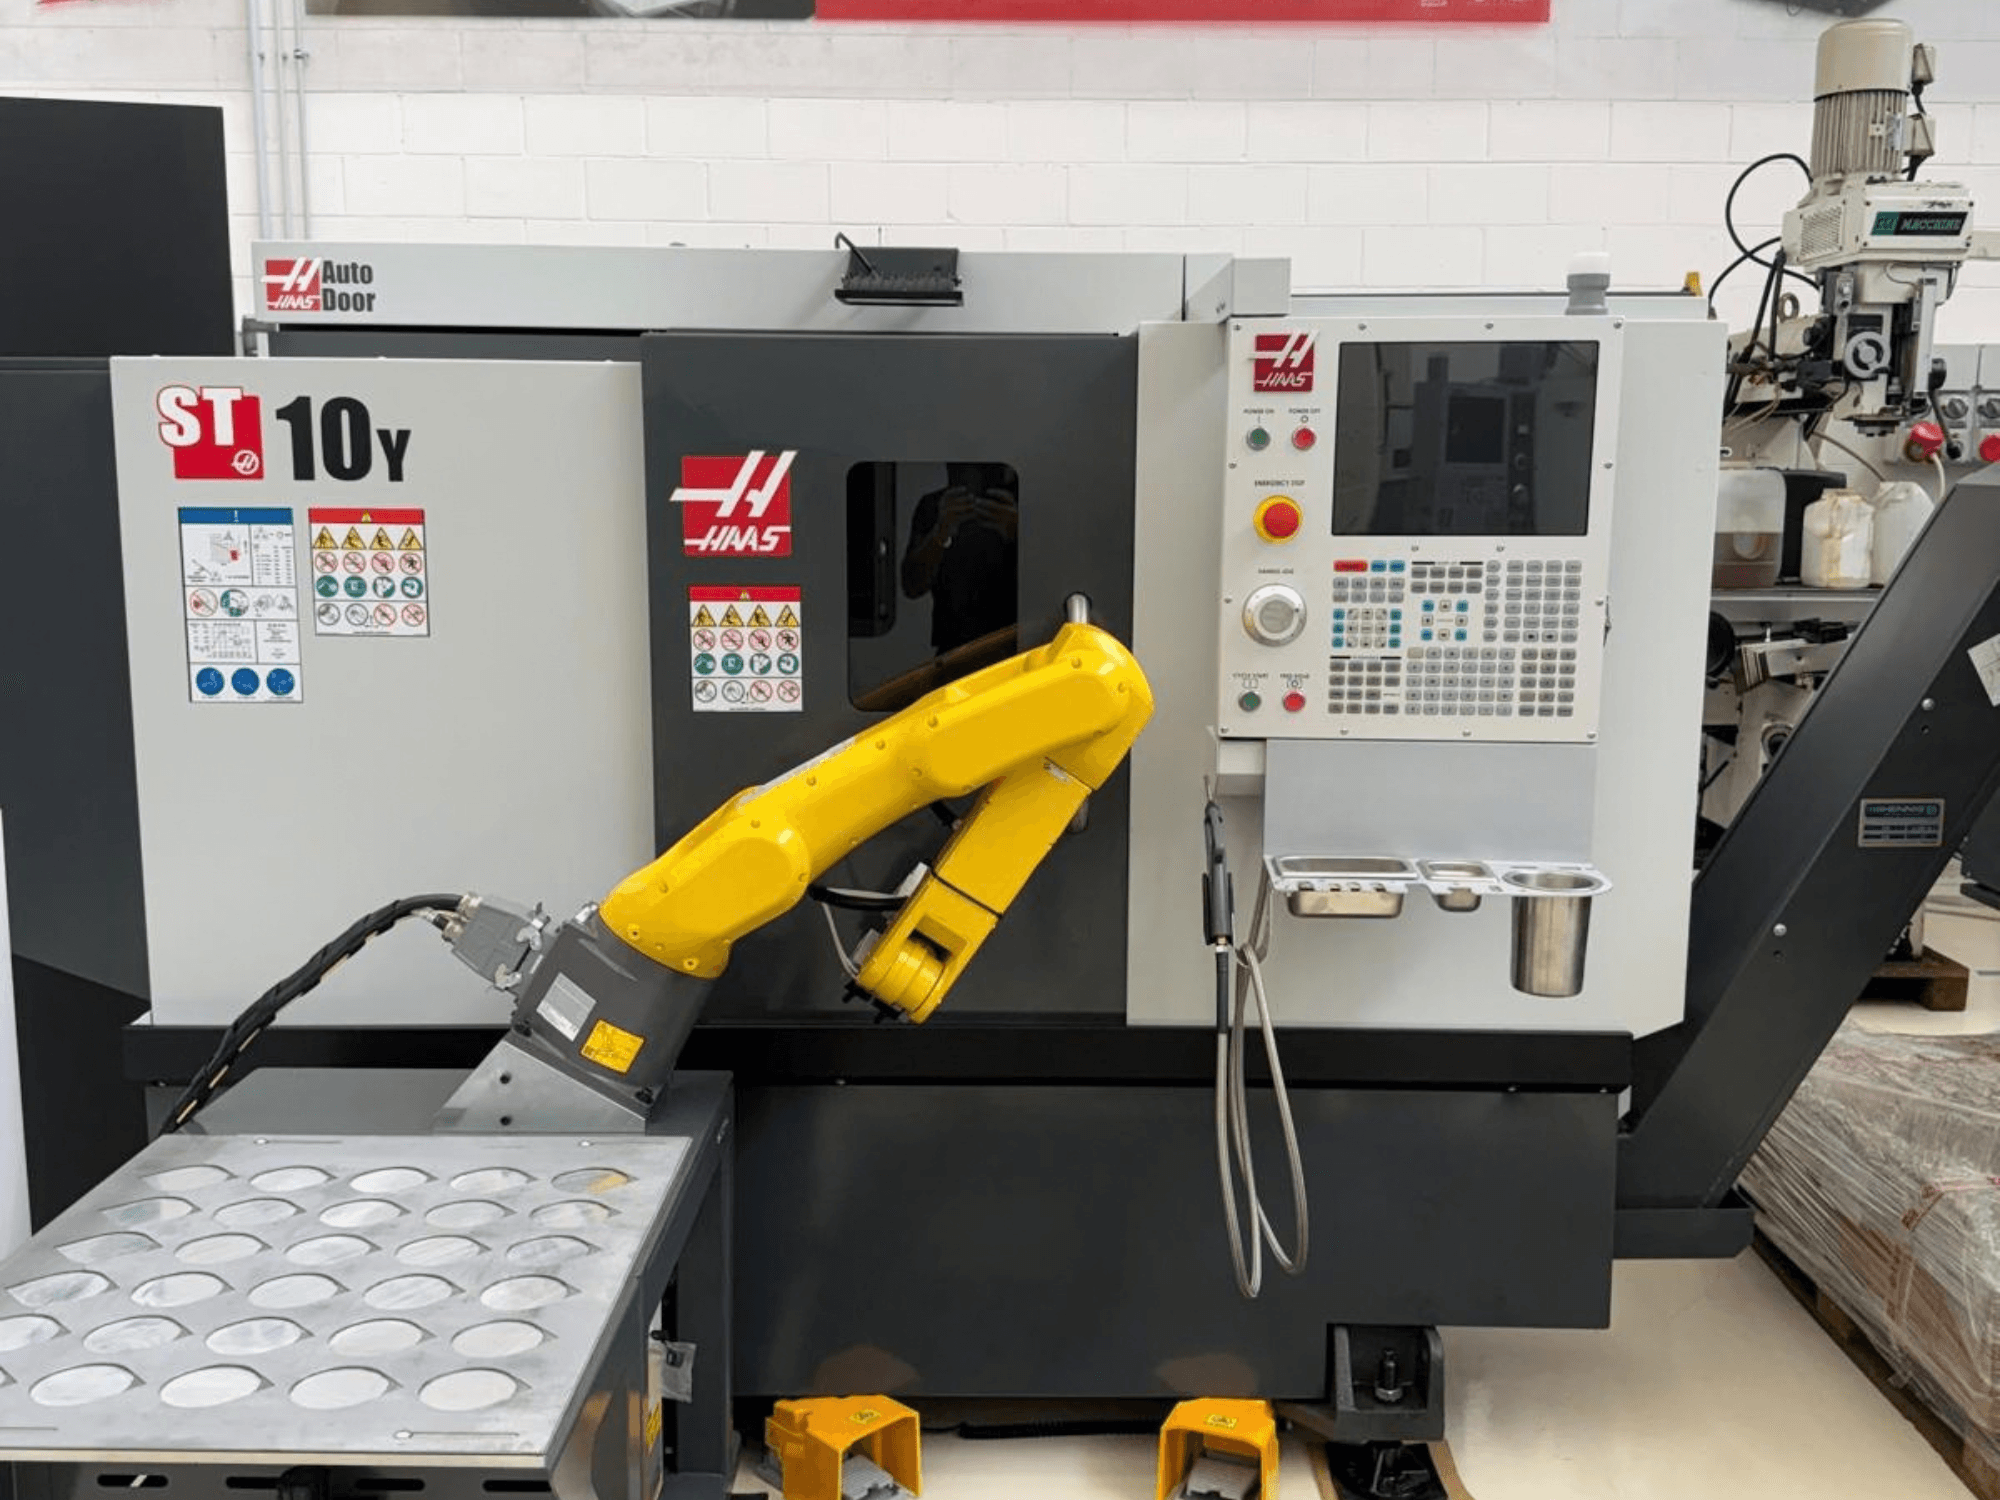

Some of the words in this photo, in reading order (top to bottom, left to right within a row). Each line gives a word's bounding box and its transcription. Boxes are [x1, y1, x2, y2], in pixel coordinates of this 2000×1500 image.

[322, 260, 374, 285] Auto
[266, 294, 321, 310] HAAS
[322, 287, 376, 313] Door
[1255, 371, 1313, 388] HAAS
[157, 385, 244, 447] ST
[683, 524, 791, 552] HAAS
